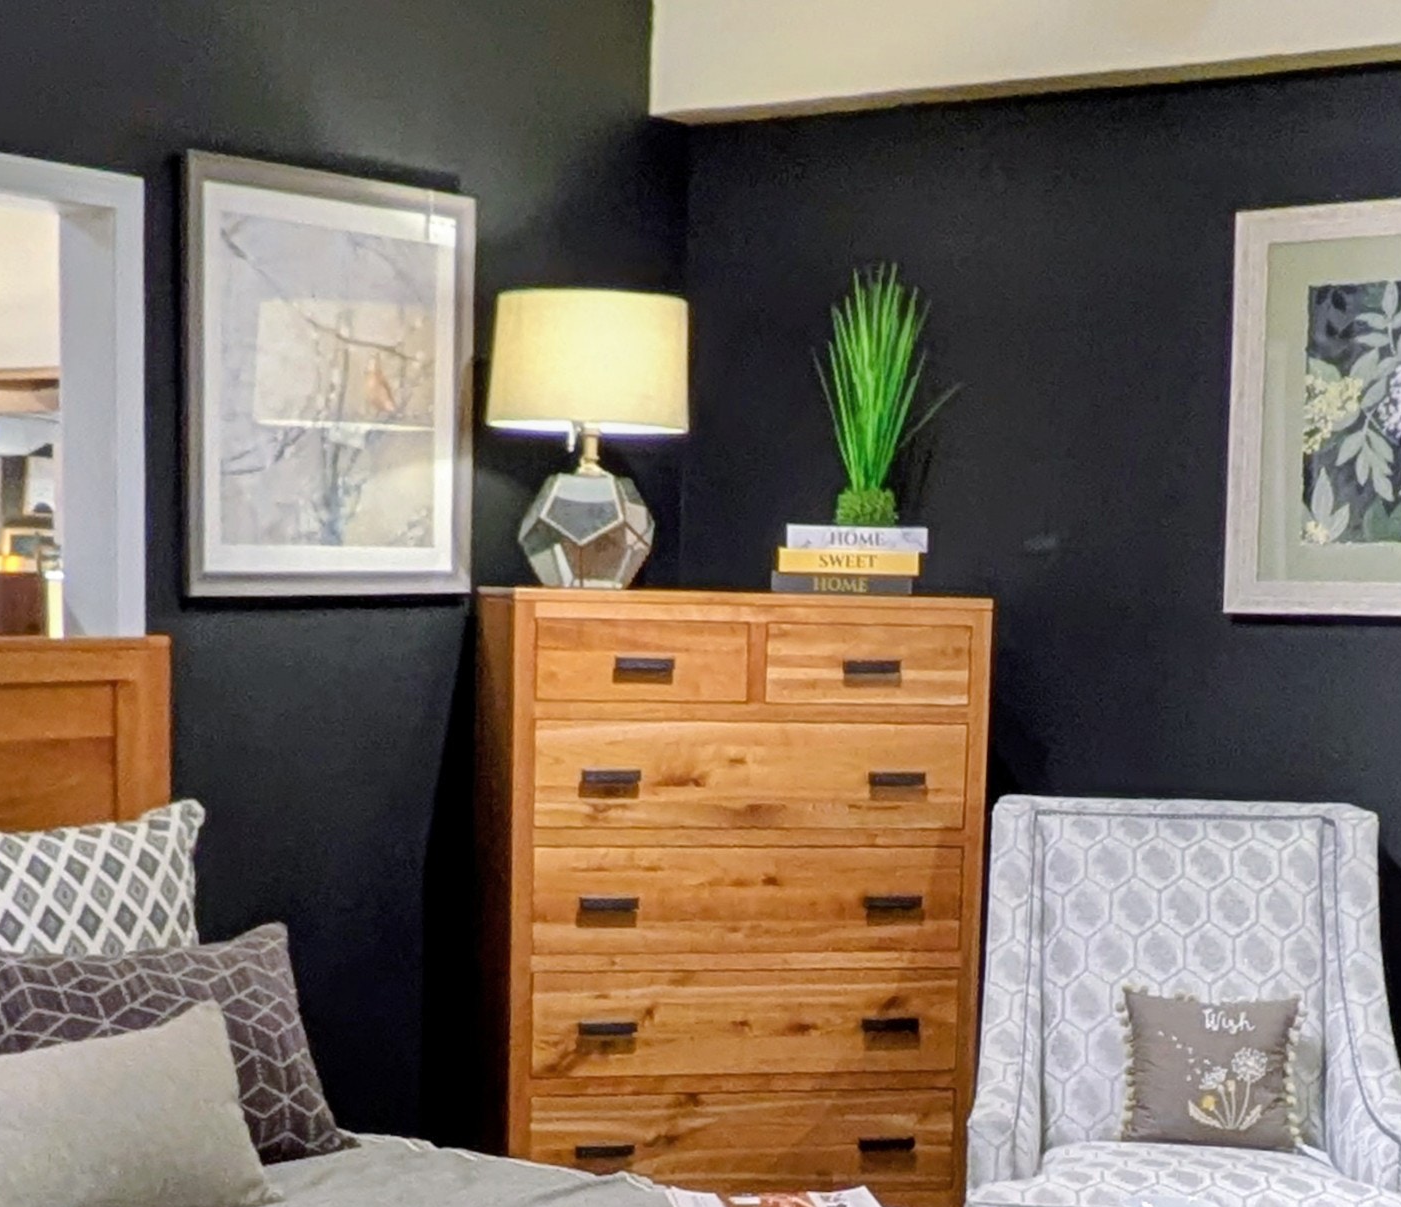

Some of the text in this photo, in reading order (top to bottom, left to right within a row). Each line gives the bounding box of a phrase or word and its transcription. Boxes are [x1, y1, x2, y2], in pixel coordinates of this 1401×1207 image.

[829, 531, 885, 547] HOME
[818, 553, 878, 569] SWEET
[812, 576, 869, 592] HOME
[1202, 1009, 1256, 1034] Wish
